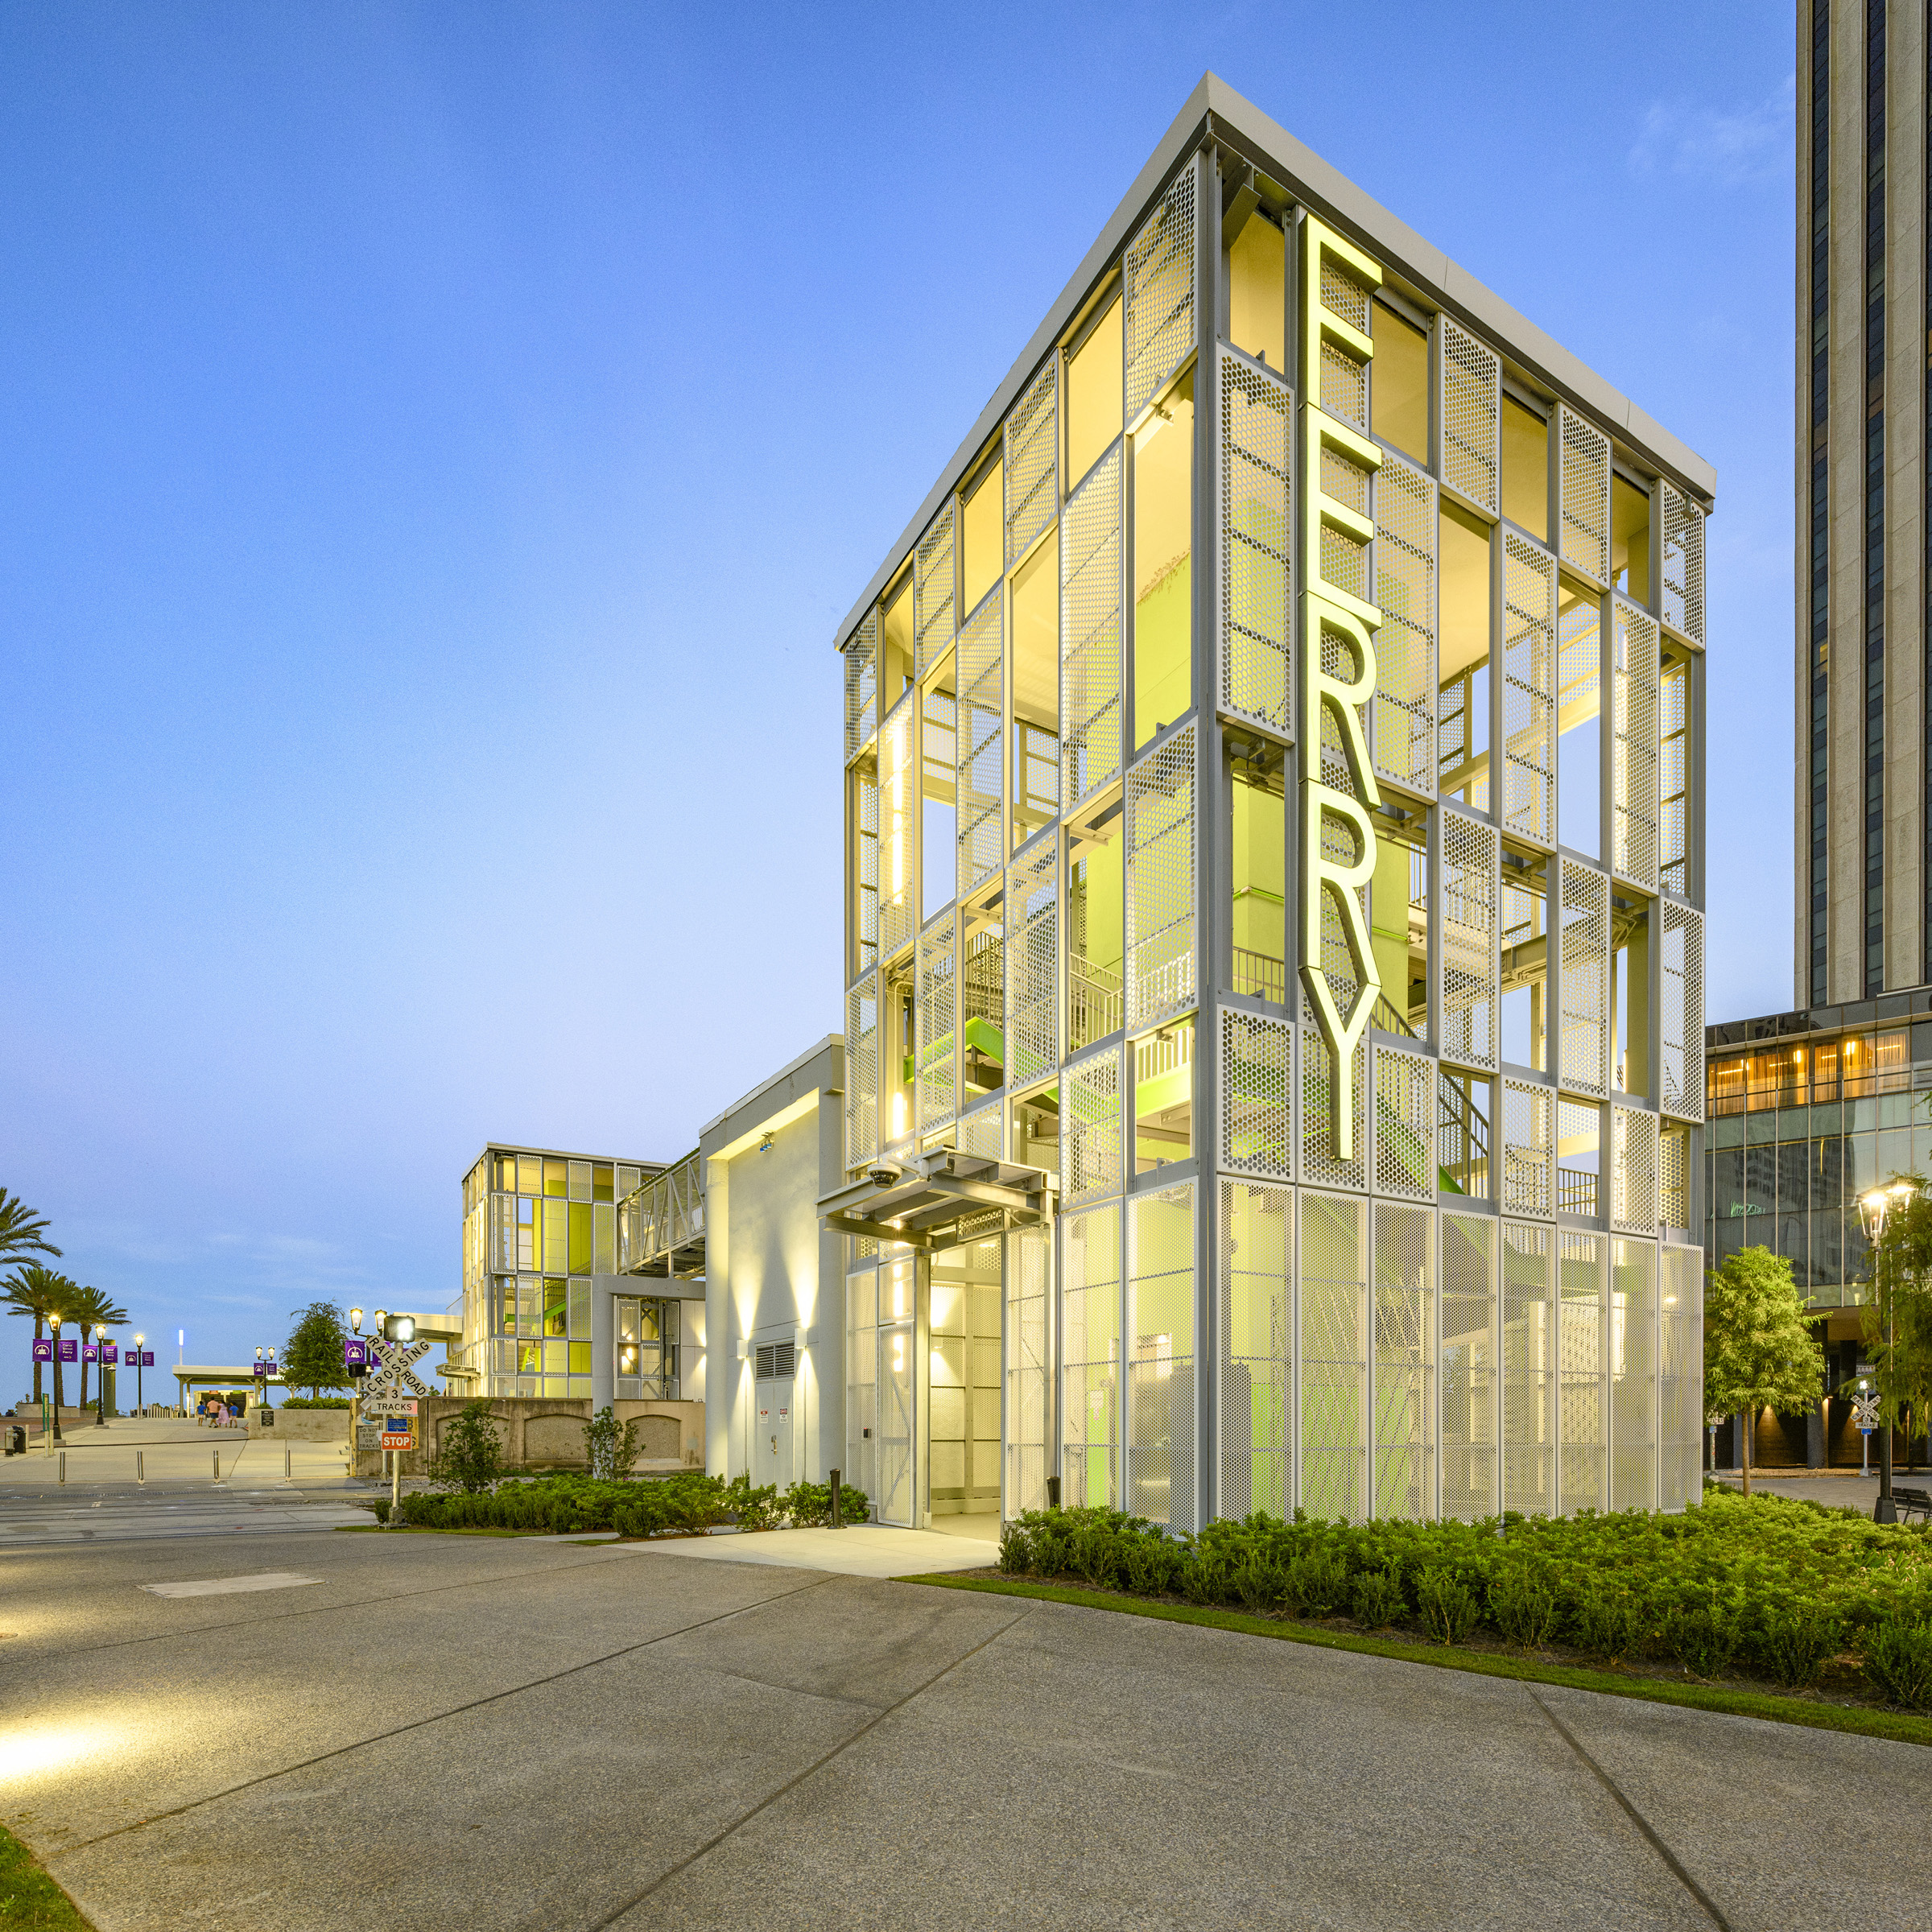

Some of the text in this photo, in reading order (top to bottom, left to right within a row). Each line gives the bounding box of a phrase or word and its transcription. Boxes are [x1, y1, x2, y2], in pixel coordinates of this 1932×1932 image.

[1298, 213, 1383, 1162] FERRY
[367, 1341, 429, 1392] CROSSING
[369, 1337, 426, 1395] RAIL ROAD
[391, 1389, 398, 1398] 3
[383, 1436, 410, 1447] STOP
